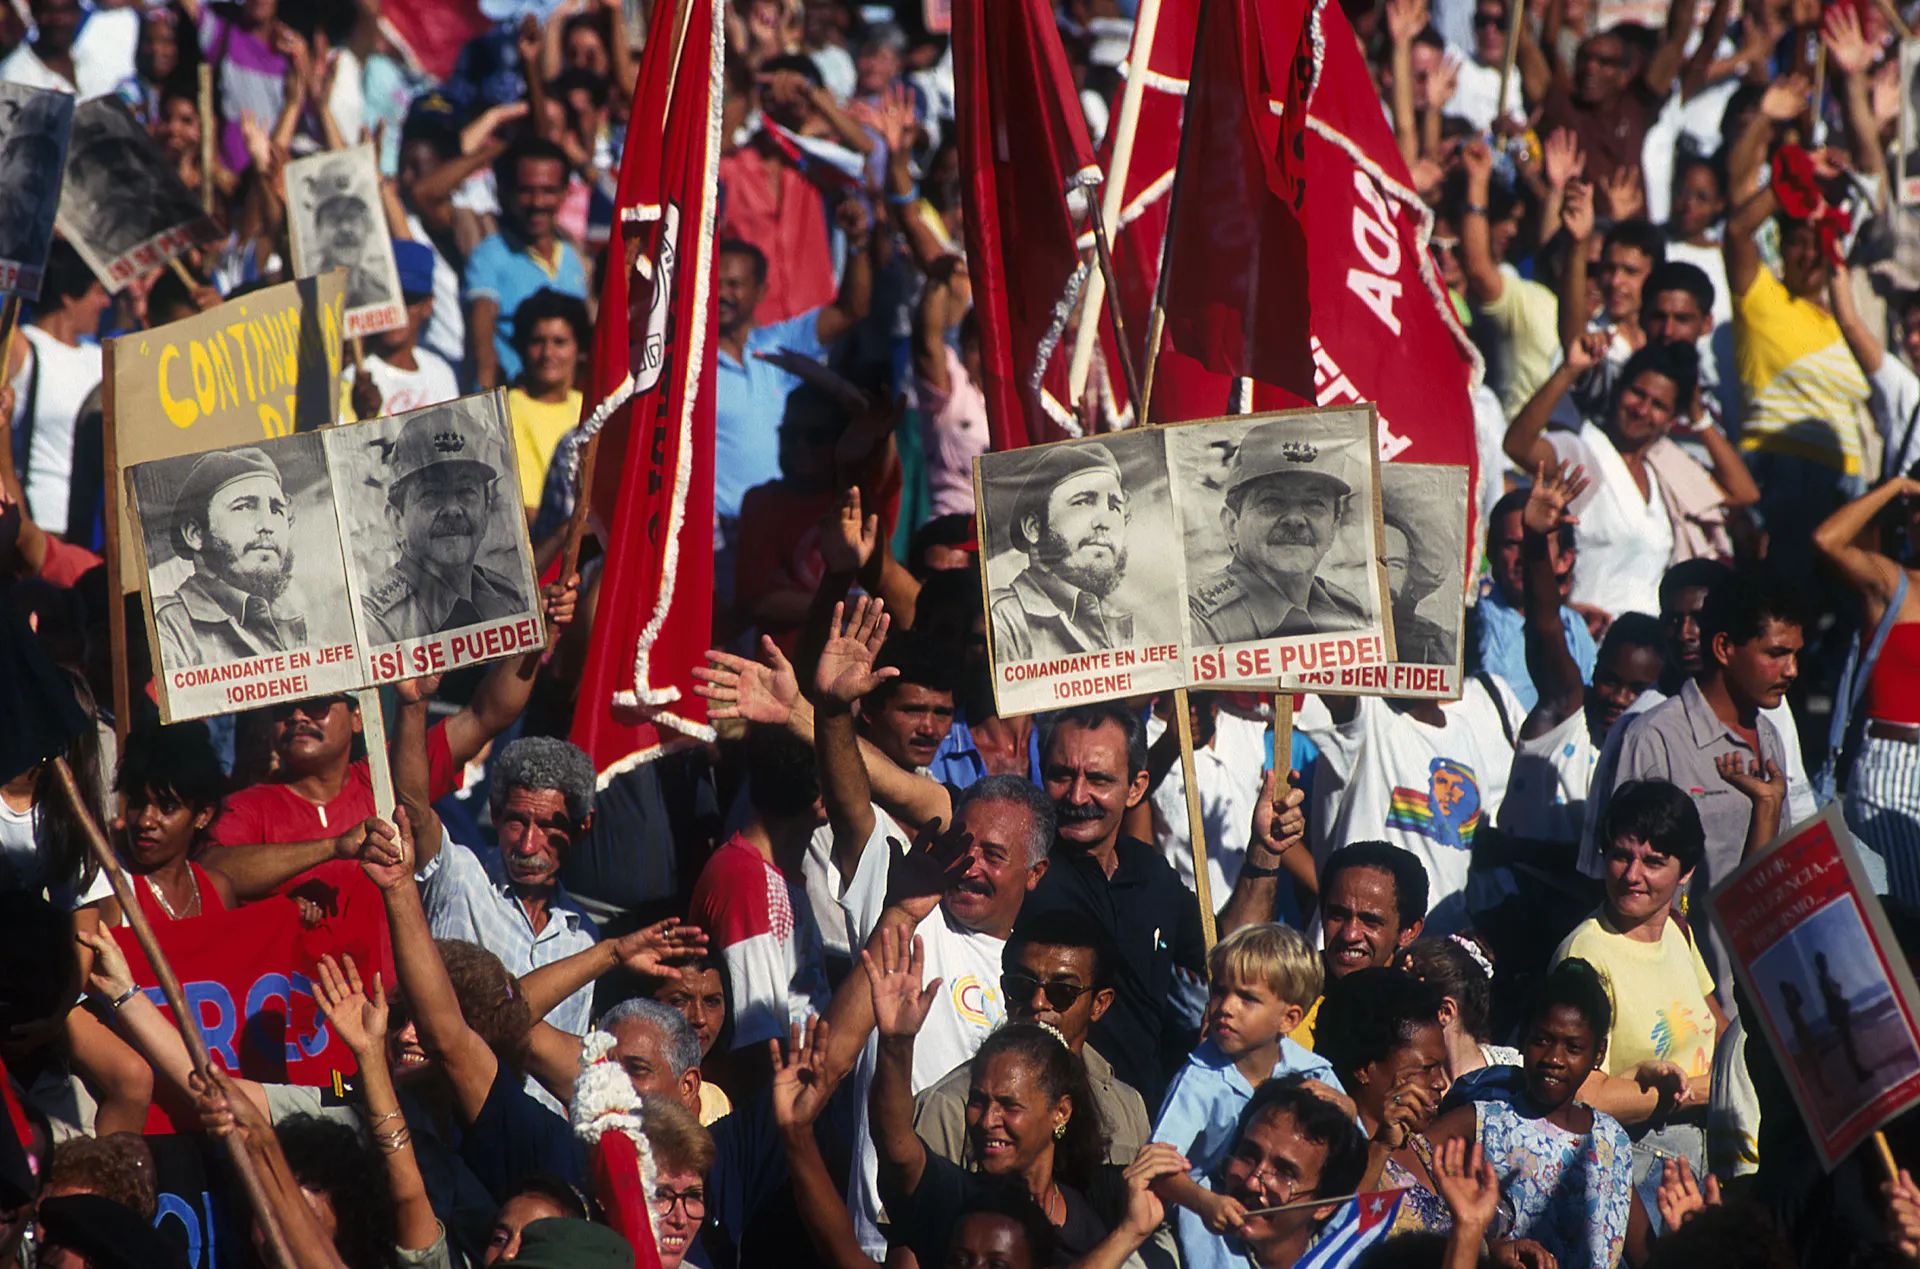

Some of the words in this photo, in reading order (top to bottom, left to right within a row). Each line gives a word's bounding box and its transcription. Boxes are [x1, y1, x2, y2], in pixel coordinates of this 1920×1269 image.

[174, 656, 285, 688] COMANDANTE
[289, 652, 311, 670] EN
[316, 644, 355, 665] JEFE
[370, 644, 405, 681] ¡SÍ
[412, 641, 446, 672] SE
[451, 618, 540, 664] PUEDE!
[1004, 653, 1110, 682] COMANDANTE
[1115, 650, 1136, 666] EN
[1140, 644, 1178, 663] JEFE
[1192, 646, 1226, 681] ¡SÍ
[1236, 648, 1272, 677] SE
[1280, 636, 1383, 672] PUEDE!
[1341, 666, 1388, 688] BIEN
[1394, 667, 1450, 692] FIDEL
